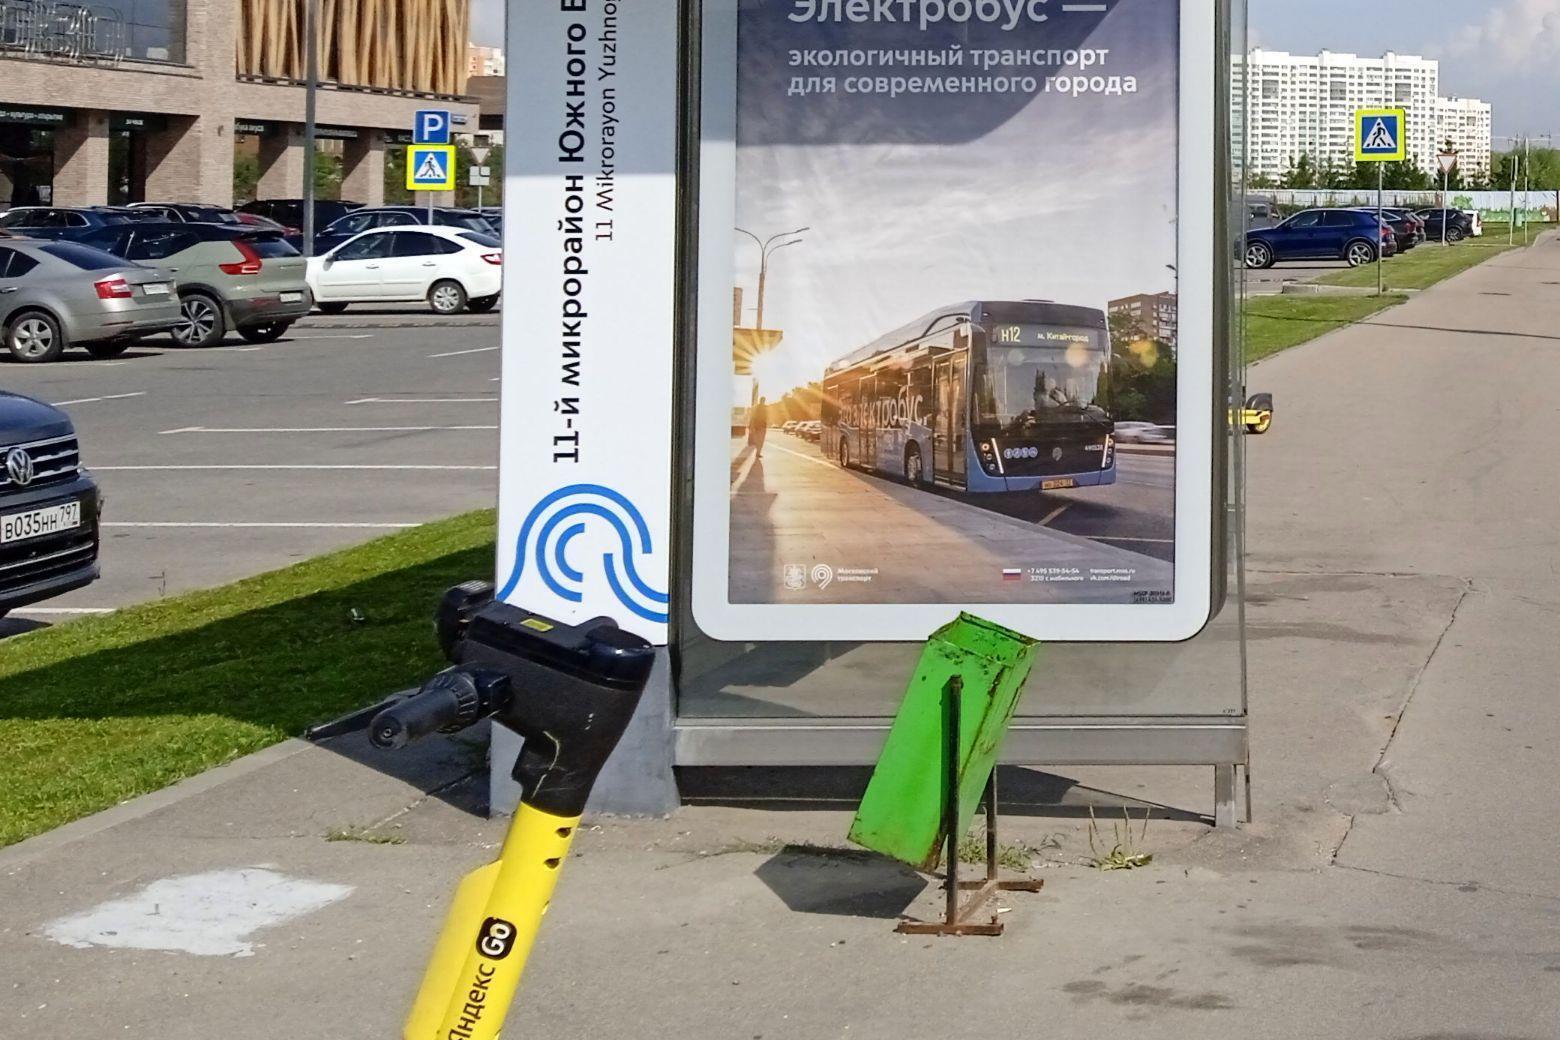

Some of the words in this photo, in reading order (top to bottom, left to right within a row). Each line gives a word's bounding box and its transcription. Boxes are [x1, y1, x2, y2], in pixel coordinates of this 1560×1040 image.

[788, 45, 963, 67] экологичный
[970, 49, 1109, 70] транспорт
[558, 22, 587, 163] Южного
[788, 76, 836, 96] для
[844, 76, 1037, 98] современного
[1044, 75, 1138, 97] города
[595, 88, 620, 211] Mikrorayon
[595, 219, 613, 241] 11
[557, 175, 589, 386] микрорайон
[552, 396, 580, 463] 11-й
[481, 922, 511, 956] Go
